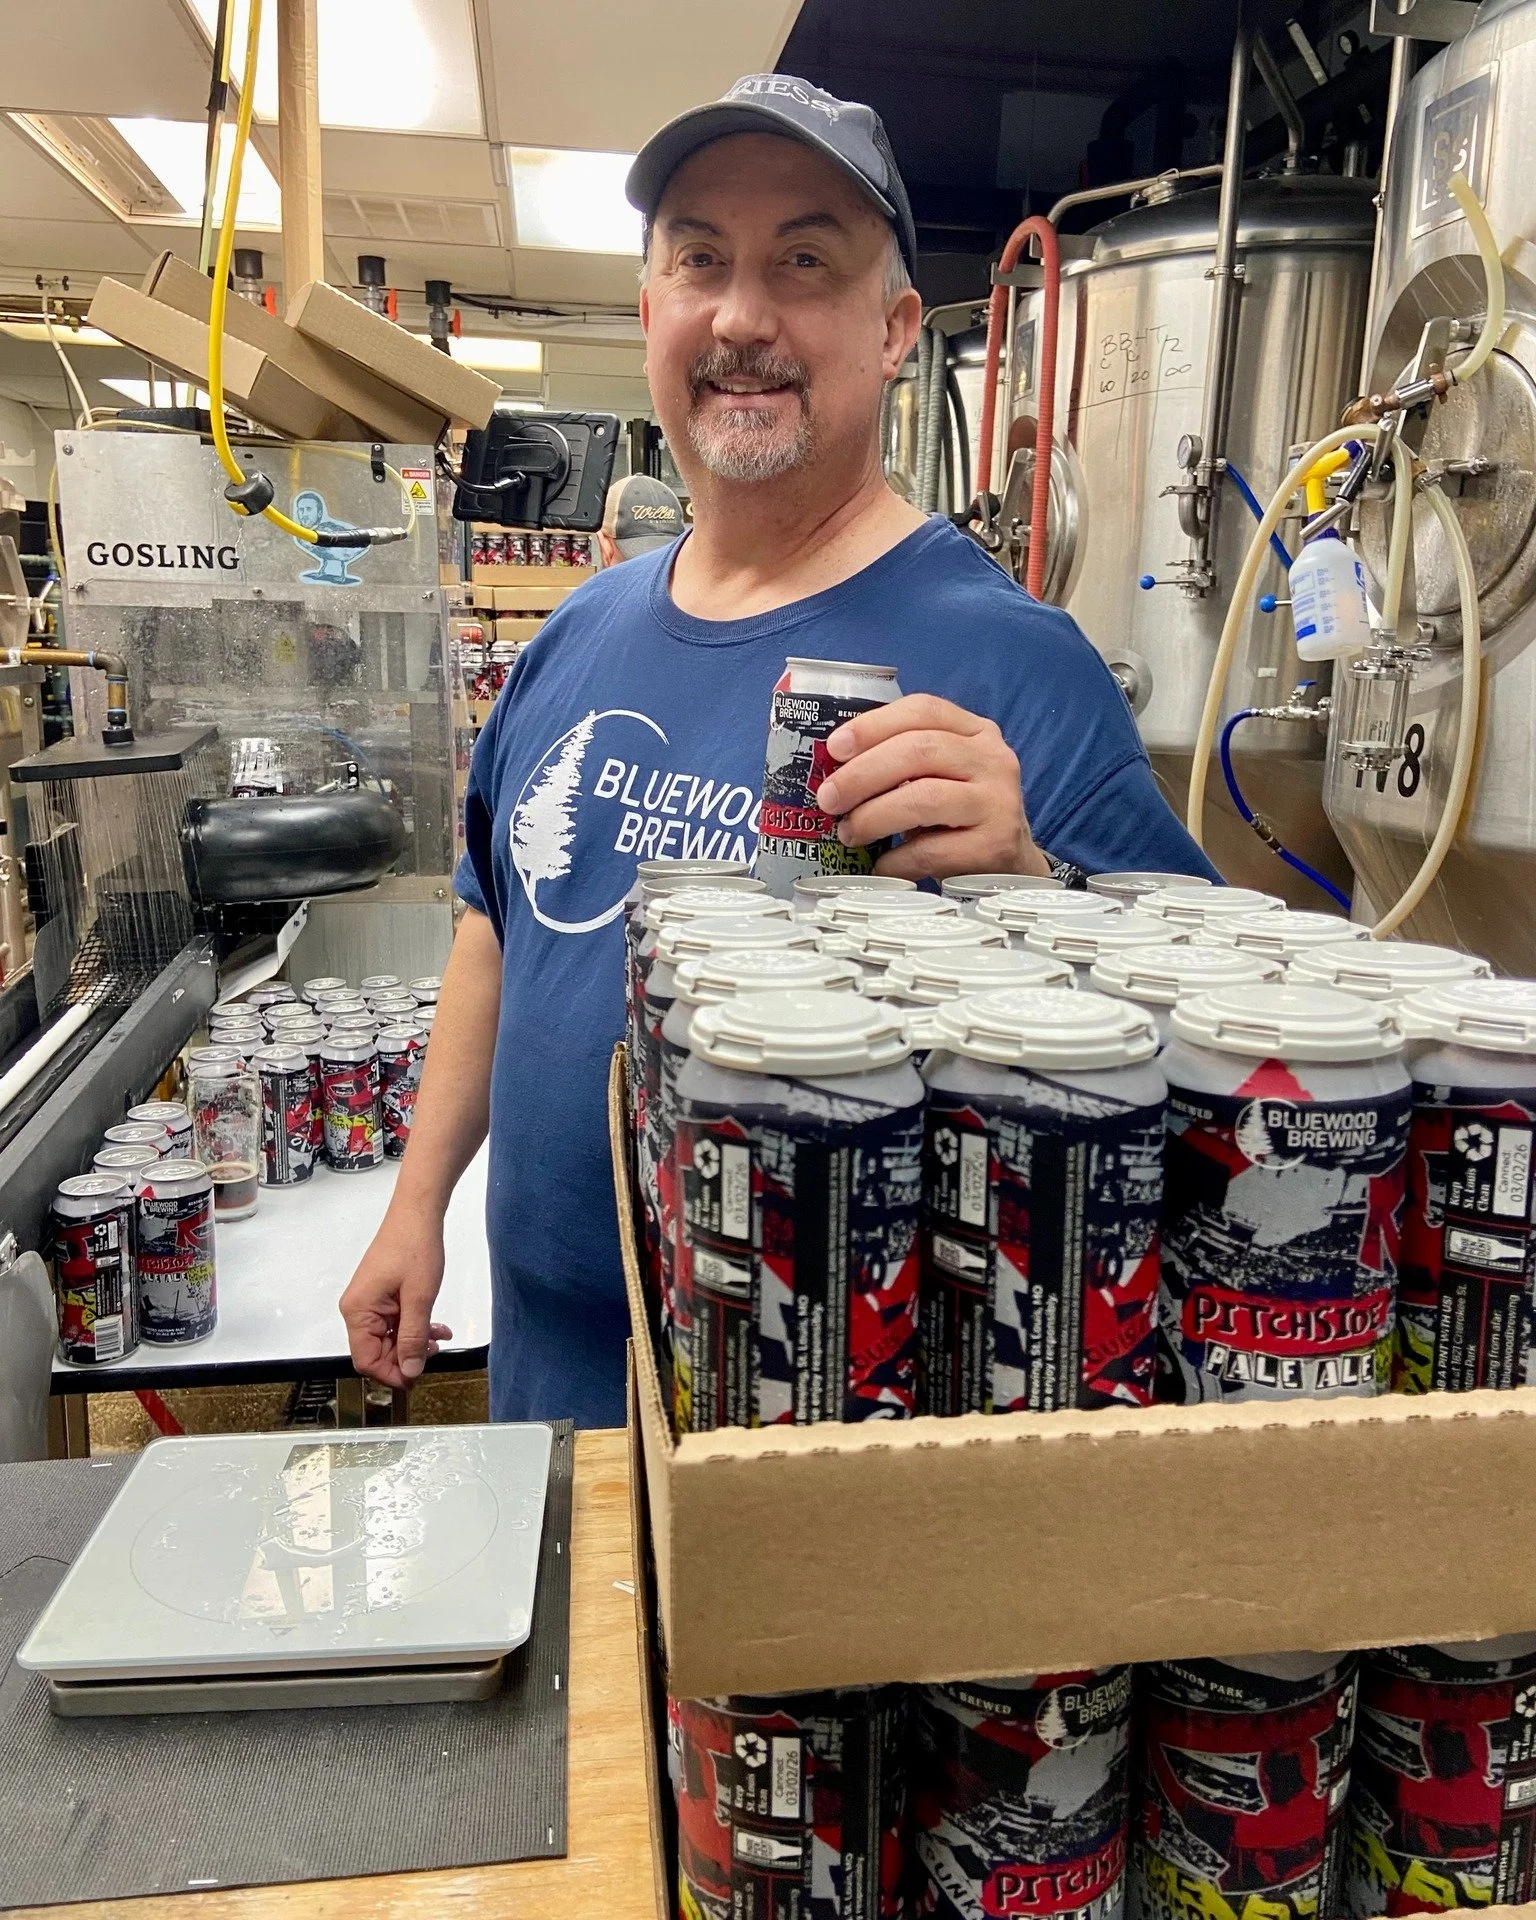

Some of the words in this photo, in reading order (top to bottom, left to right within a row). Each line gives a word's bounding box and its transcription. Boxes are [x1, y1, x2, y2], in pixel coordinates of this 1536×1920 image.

[728, 79, 831, 112] RIESS
[87, 542, 240, 570] GOSLING
[775, 697, 820, 712] BLUEWOOD
[779, 708, 819, 722] BREWING
[760, 807, 827, 834] TCHSIDE
[782, 840, 820, 862] ALE
[1267, 1109, 1378, 1130] BLUEWOOD
[1287, 1129, 1376, 1148] BREWING
[1464, 1168, 1477, 1194] Louis
[1510, 1144, 1528, 1203] 03/02/26
[1449, 1181, 1464, 1206] Keep
[1463, 1196, 1475, 1209] St.
[1477, 1183, 1491, 1212] Clean
[1195, 1294, 1384, 1344] PITCHSIDE
[1440, 1314, 1451, 1342] WITH
[1438, 1344, 1448, 1368] PINT
[1488, 1333, 1500, 1358] from
[1206, 1343, 1304, 1389] PALE
[1316, 1352, 1375, 1390] ALE
[1209, 1682, 1243, 1699] PARK
[959, 1692, 1012, 1715] BREWED
[786, 1750, 798, 1806] 03/02/26
